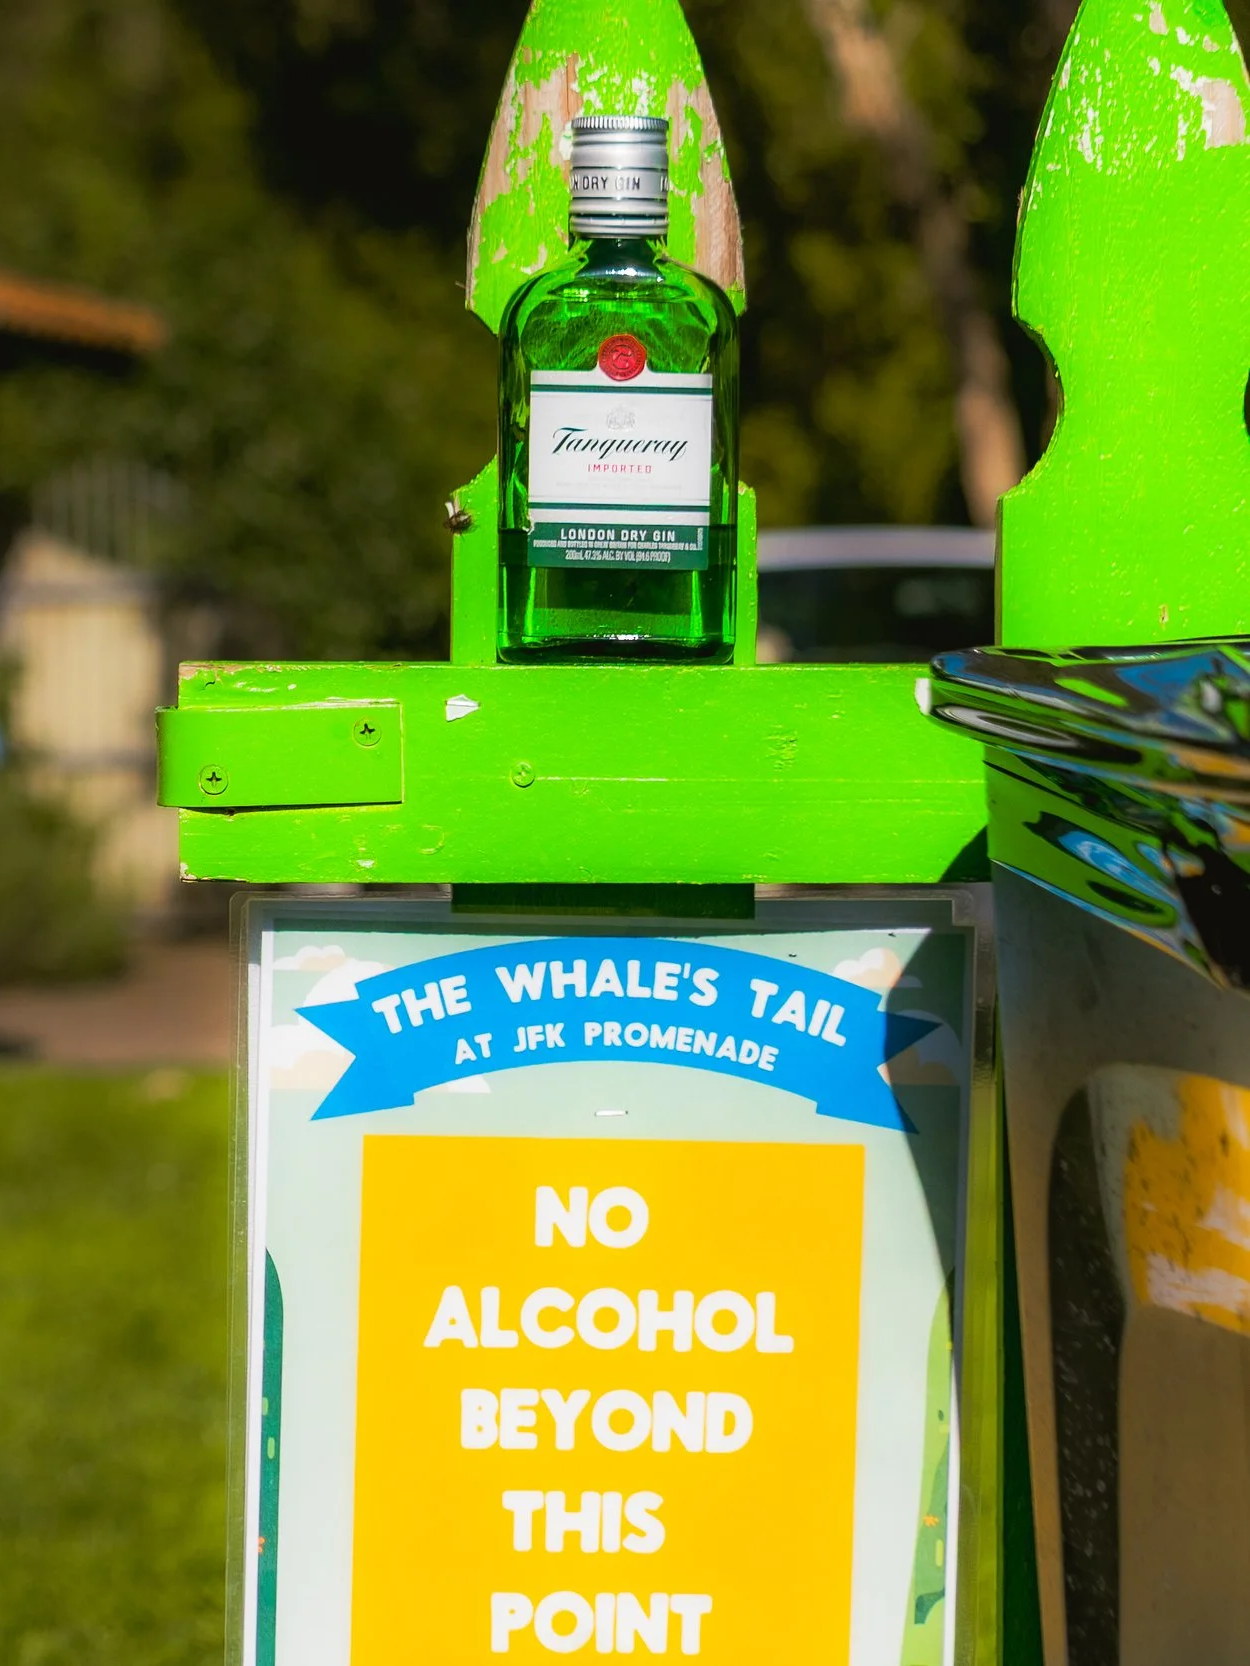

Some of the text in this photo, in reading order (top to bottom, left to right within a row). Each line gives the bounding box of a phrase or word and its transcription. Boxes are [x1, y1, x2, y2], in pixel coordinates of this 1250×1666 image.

[582, 175, 608, 191] DRY
[615, 176, 640, 191] GIN
[552, 427, 688, 461] Tanqueray
[588, 464, 652, 474] IMPORTED
[560, 528, 676, 542] LONDON DRY GIN
[372, 959, 848, 1047] THE WHALE'S TAIL
[454, 1021, 779, 1072] AT JFK PROMENADE
[535, 1185, 649, 1249] NO
[423, 1285, 794, 1353] ALCOHOL
[460, 1388, 753, 1454] BEYOND
[502, 1490, 666, 1554] THIS
[490, 1591, 713, 1655] POINT
